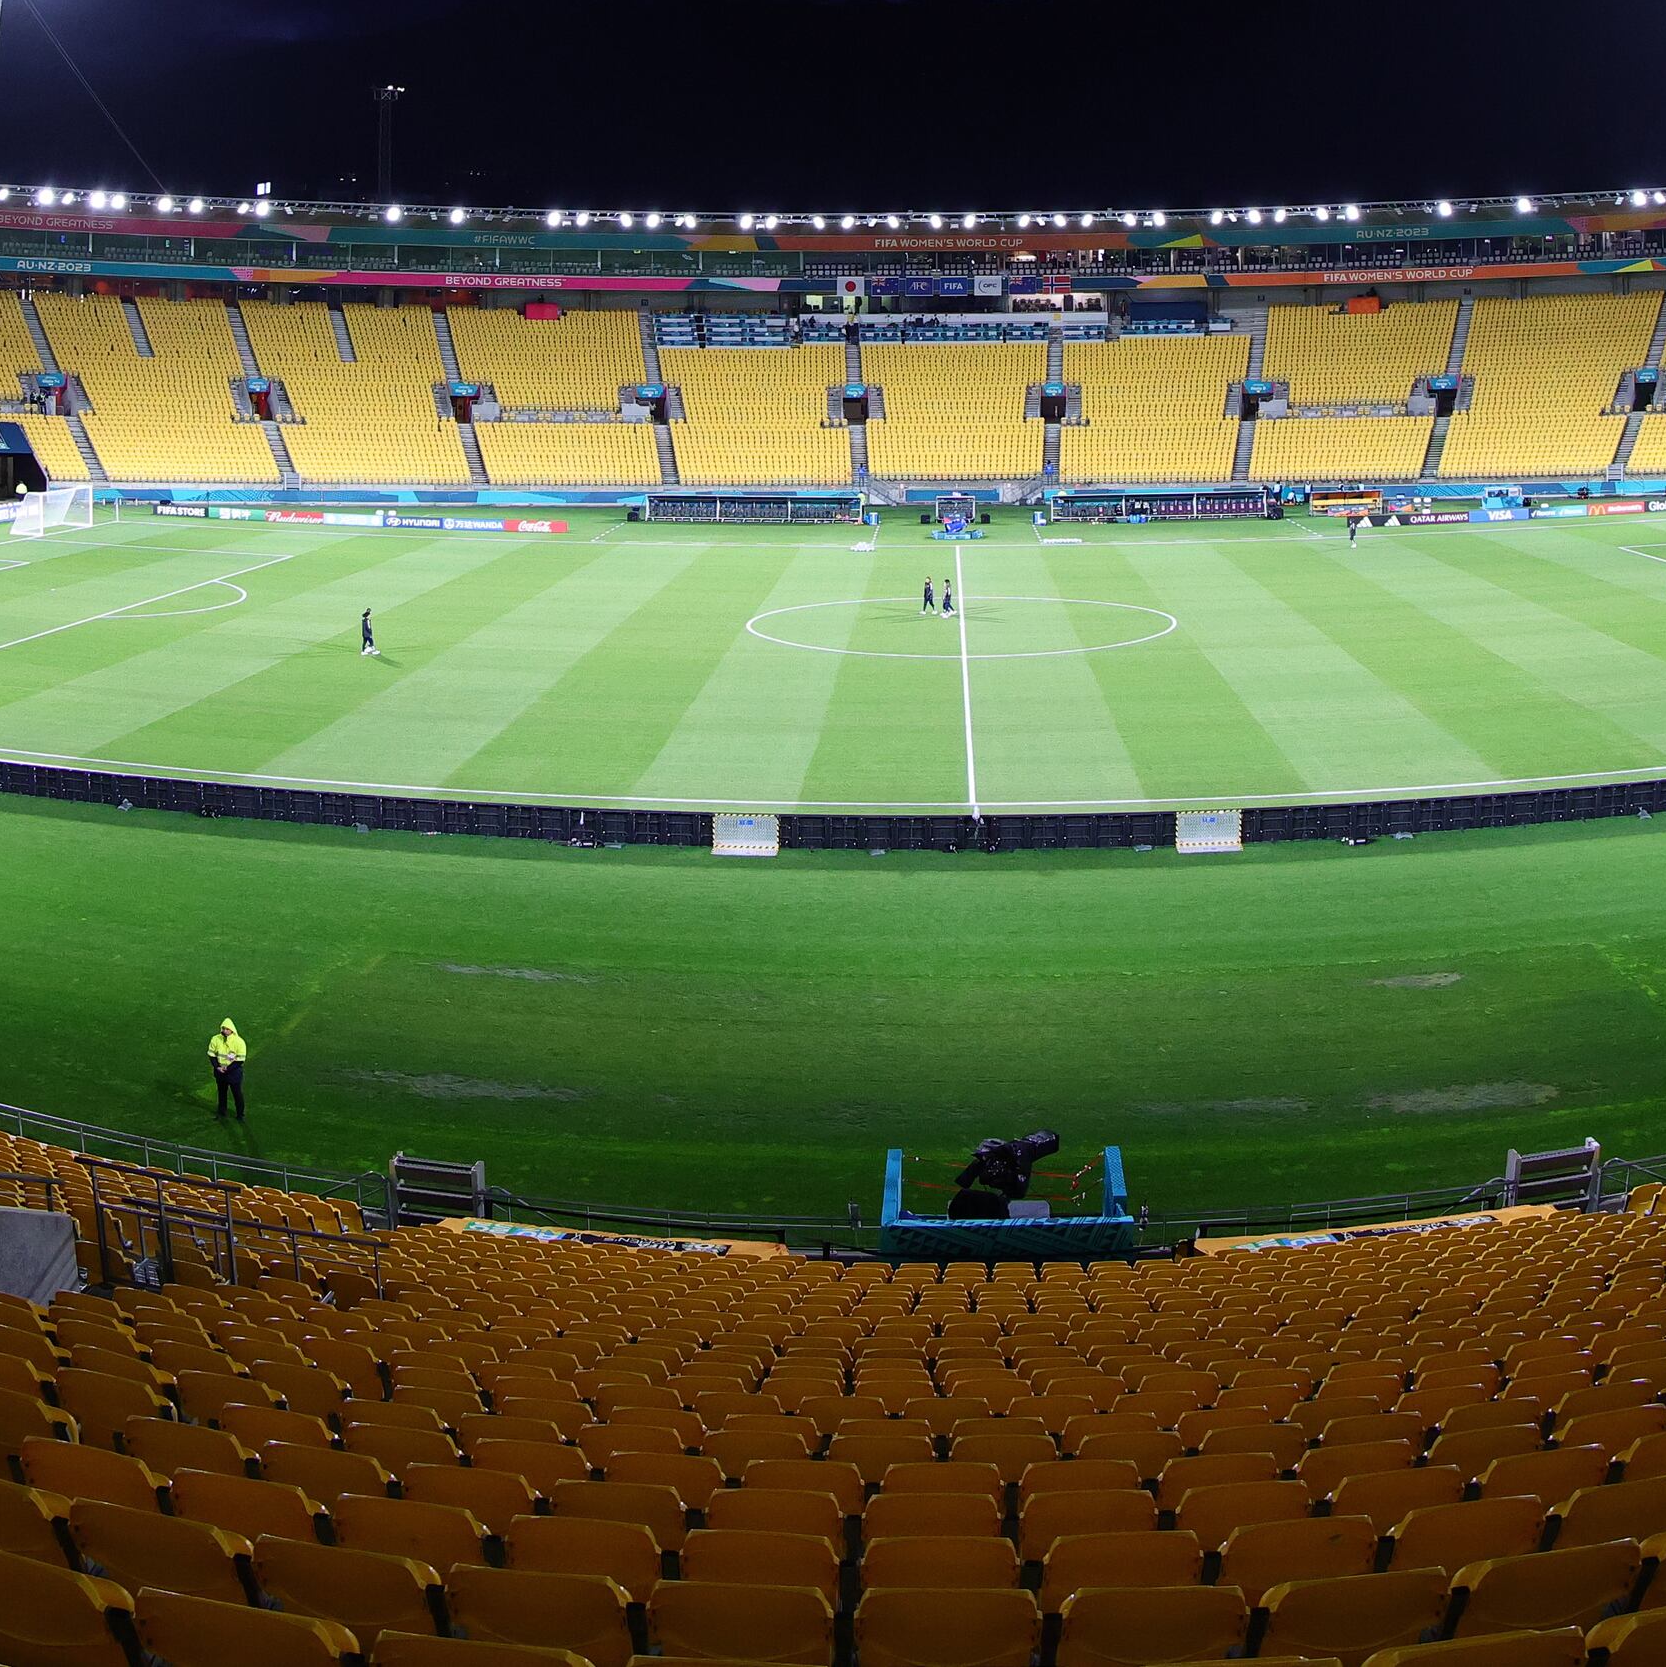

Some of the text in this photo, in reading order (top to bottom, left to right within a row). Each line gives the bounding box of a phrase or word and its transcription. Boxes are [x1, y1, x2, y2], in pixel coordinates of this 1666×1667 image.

[474, 234, 536, 245] #FIFAWWC
[874, 238, 1024, 248] FIFA WOMEN'S WORLD CUP
[1323, 268, 1474, 282] FIFA WOMEN'S WORLD CUP
[445, 276, 492, 286] BEYOND
[943, 282, 964, 291] FIFA
[157, 506, 206, 517] FIFA STORE
[1487, 510, 1513, 521] VISA
[265, 511, 323, 524] Budweiser
[402, 519, 440, 527] HYUNDAI
[1410, 513, 1468, 524] QATAR AIRWAYS
